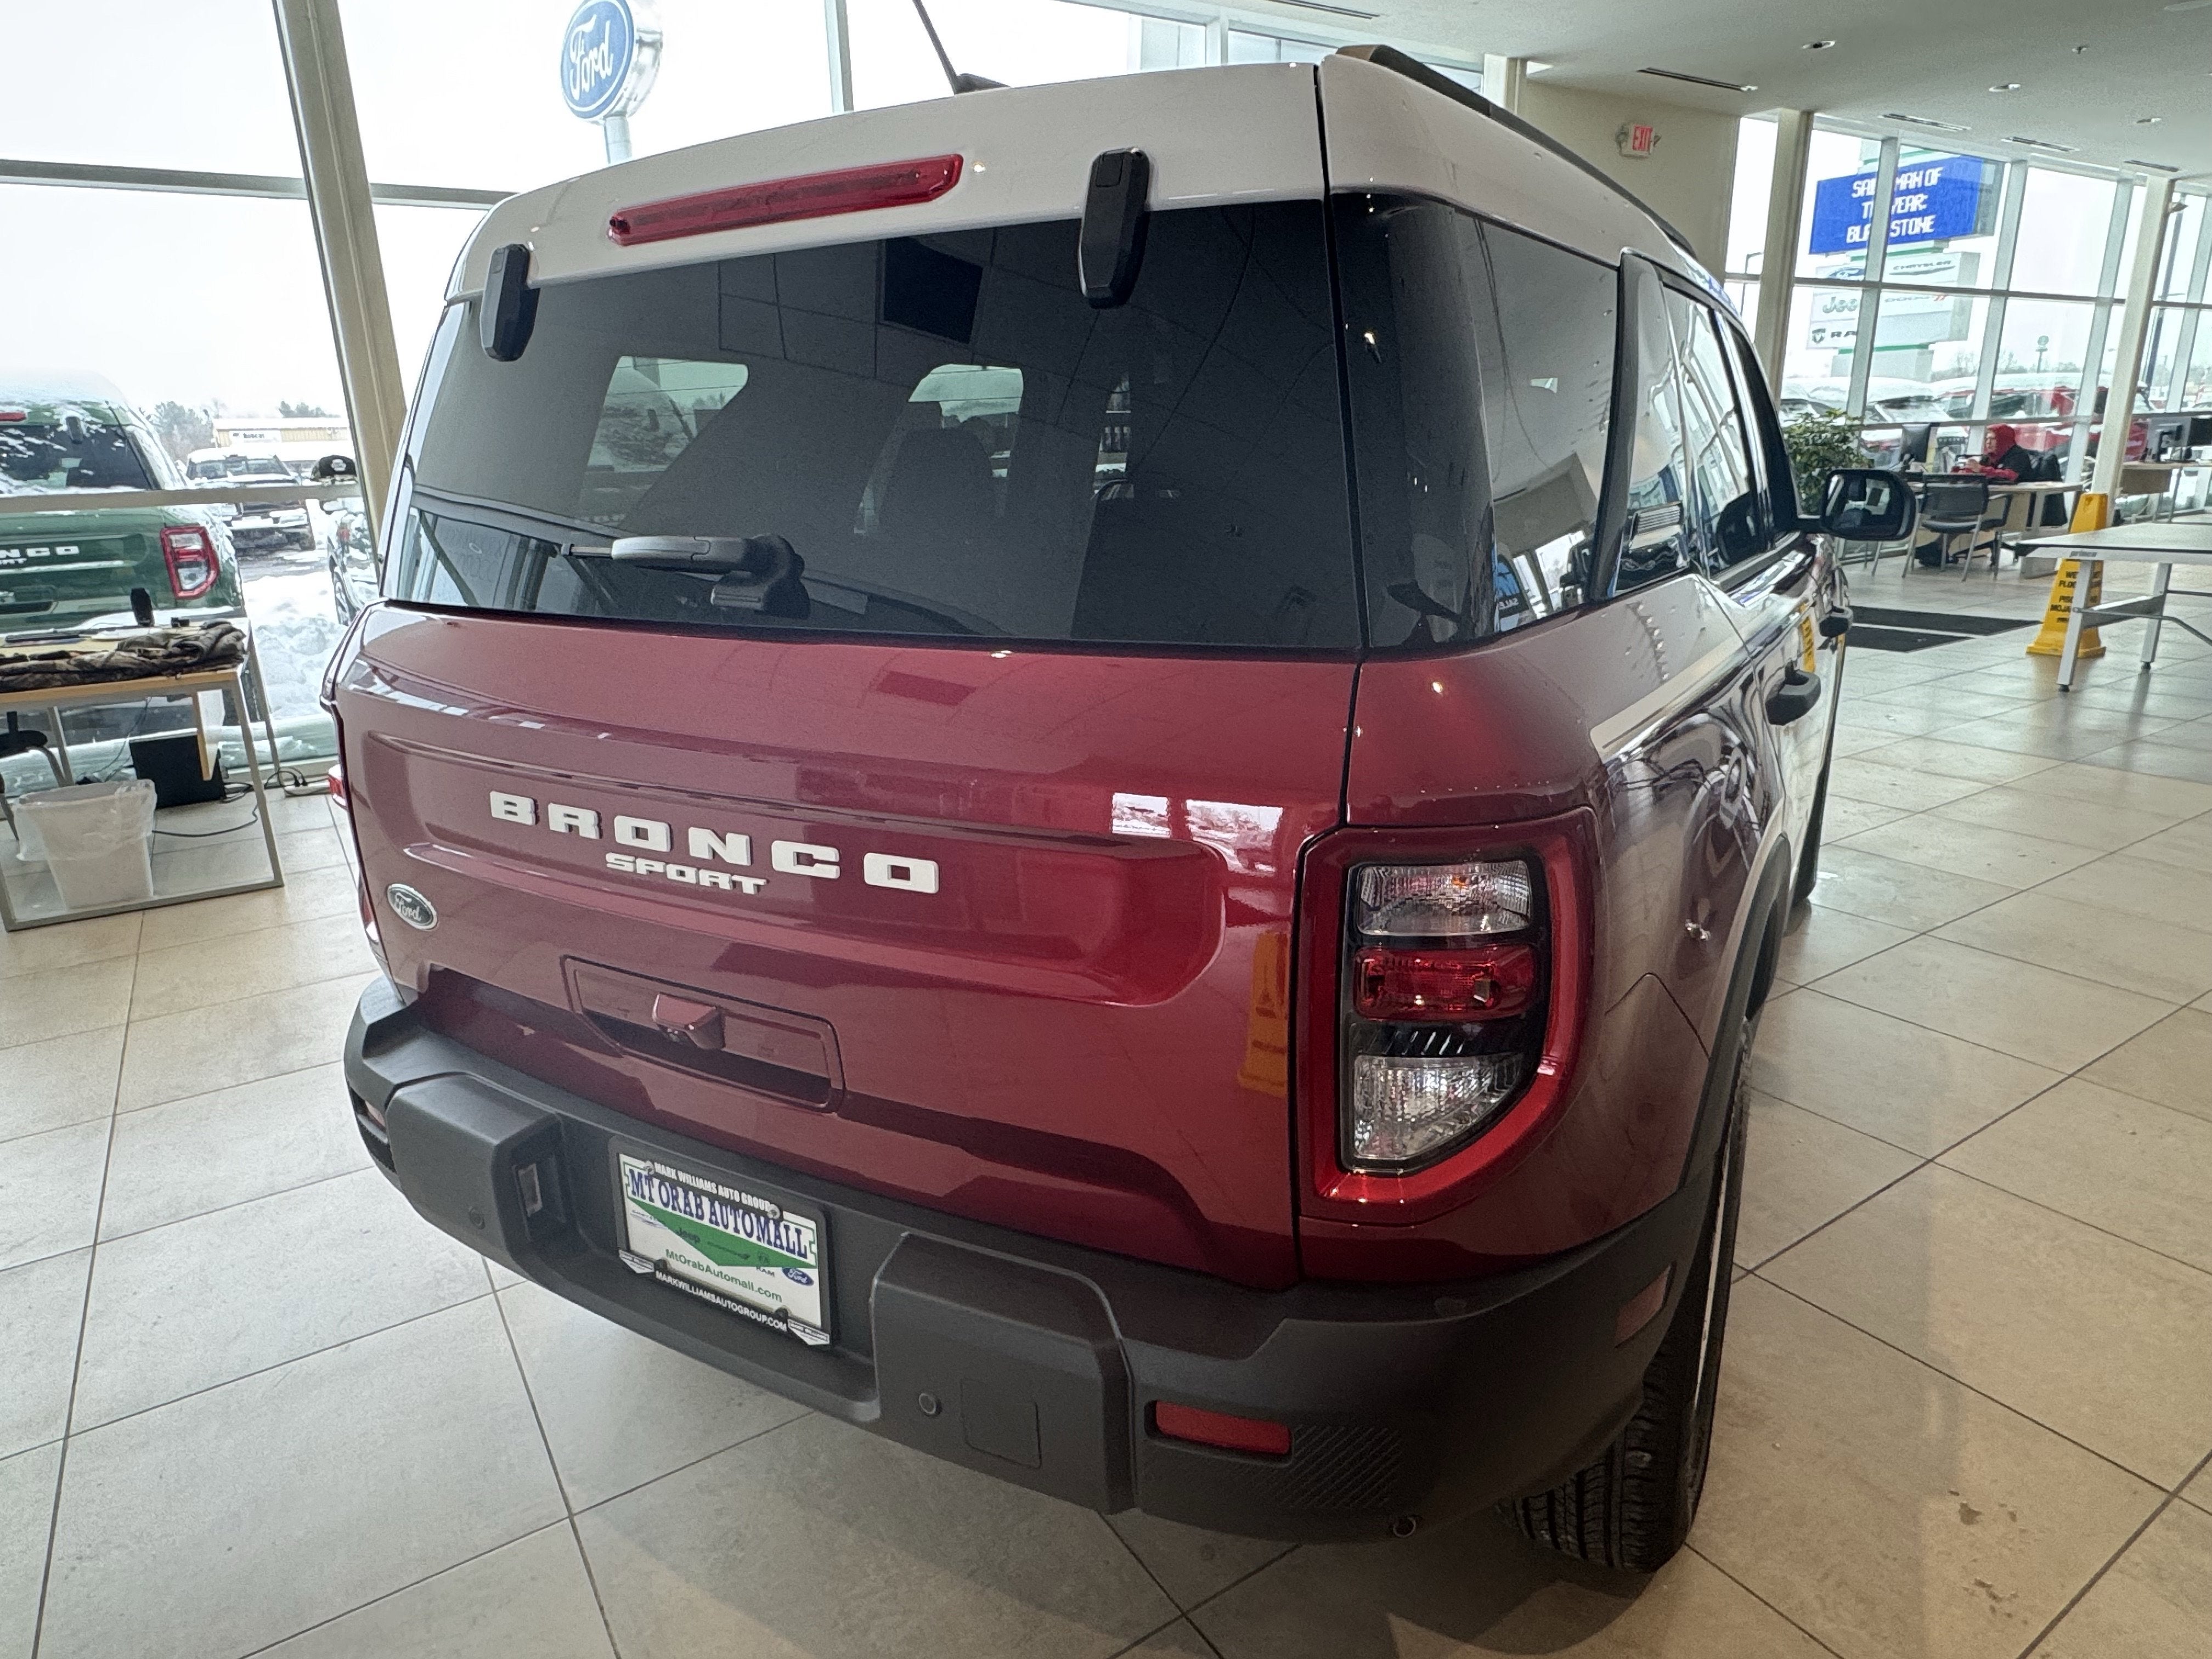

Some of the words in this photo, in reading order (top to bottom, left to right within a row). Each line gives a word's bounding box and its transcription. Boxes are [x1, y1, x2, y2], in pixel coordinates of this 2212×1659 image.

[569, 14, 614, 101] Ford
[1925, 167, 1943, 187] OF
[1822, 297, 1858, 314] Jee
[1831, 330, 1857, 338] RA
[489, 791, 939, 894] BRONCO
[606, 852, 768, 895] SPORT
[394, 891, 422, 922] Ford
[654, 1161, 678, 1180] MARK
[677, 1170, 718, 1194] WILLIAMS
[718, 1184, 740, 1203] AUTO
[629, 1168, 654, 1203] MT
[658, 1180, 704, 1221] ORAB
[709, 1195, 808, 1260] AUTOMALL
[665, 1248, 782, 1303] MtOrabAutomall.com
[787, 1267, 809, 1284] Ford
[656, 1270, 787, 1332] MARKWILLIAMSAUTOGROUP.COM
